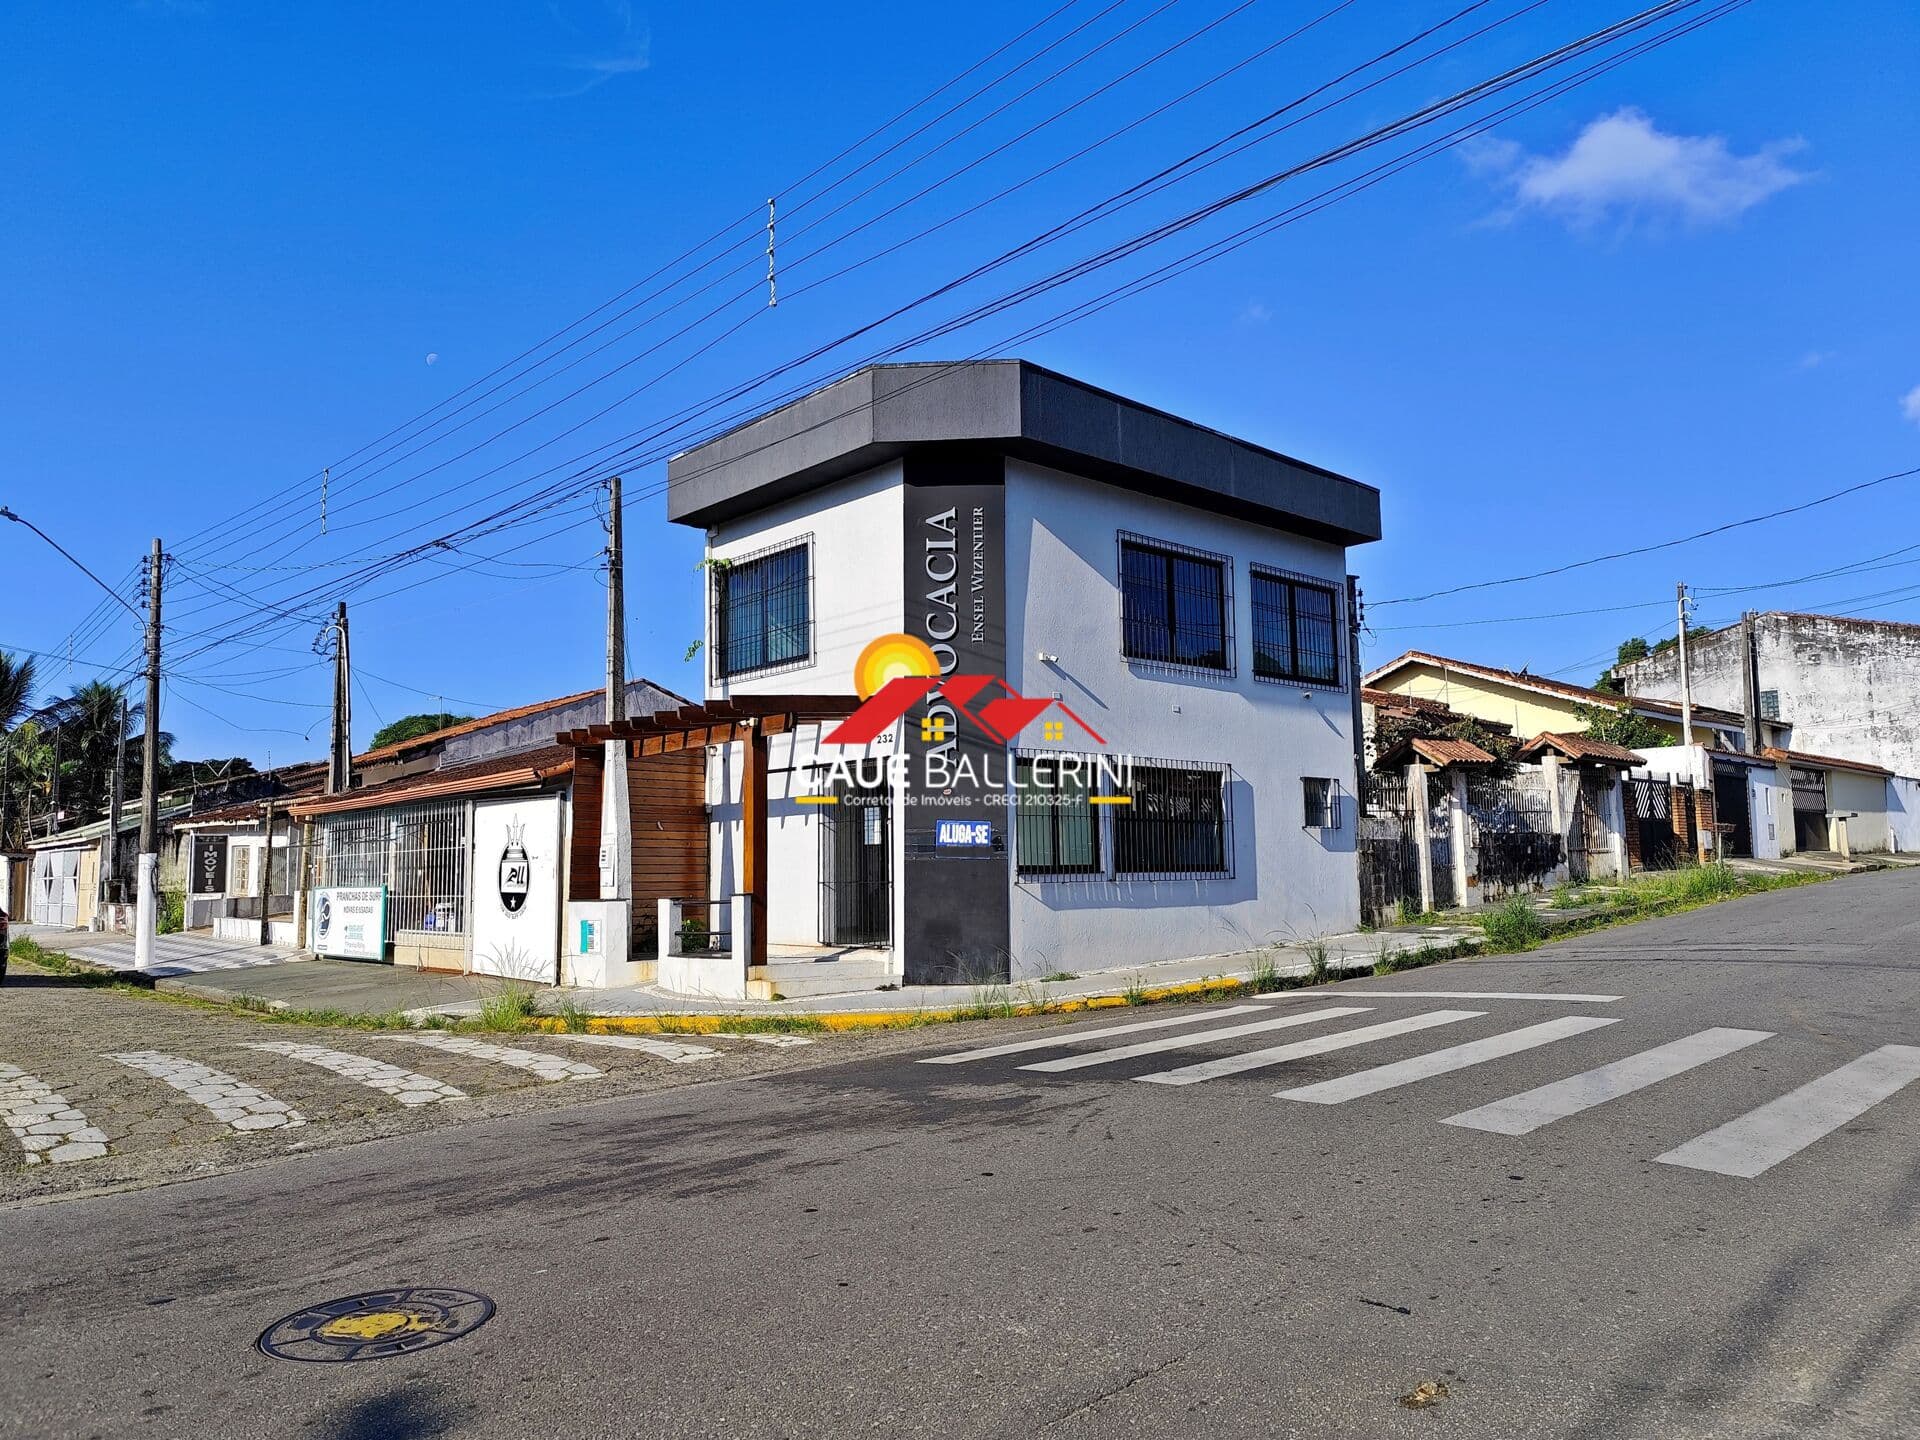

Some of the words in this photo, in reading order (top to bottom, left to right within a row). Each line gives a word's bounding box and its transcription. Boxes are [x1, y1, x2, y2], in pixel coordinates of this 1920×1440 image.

[970, 506, 985, 592] WIZENTIER
[971, 595, 985, 644] ENSEL
[876, 733, 894, 744] 232
[939, 823, 988, 844] ALUGA-SE
[361, 891, 369, 901] DE
